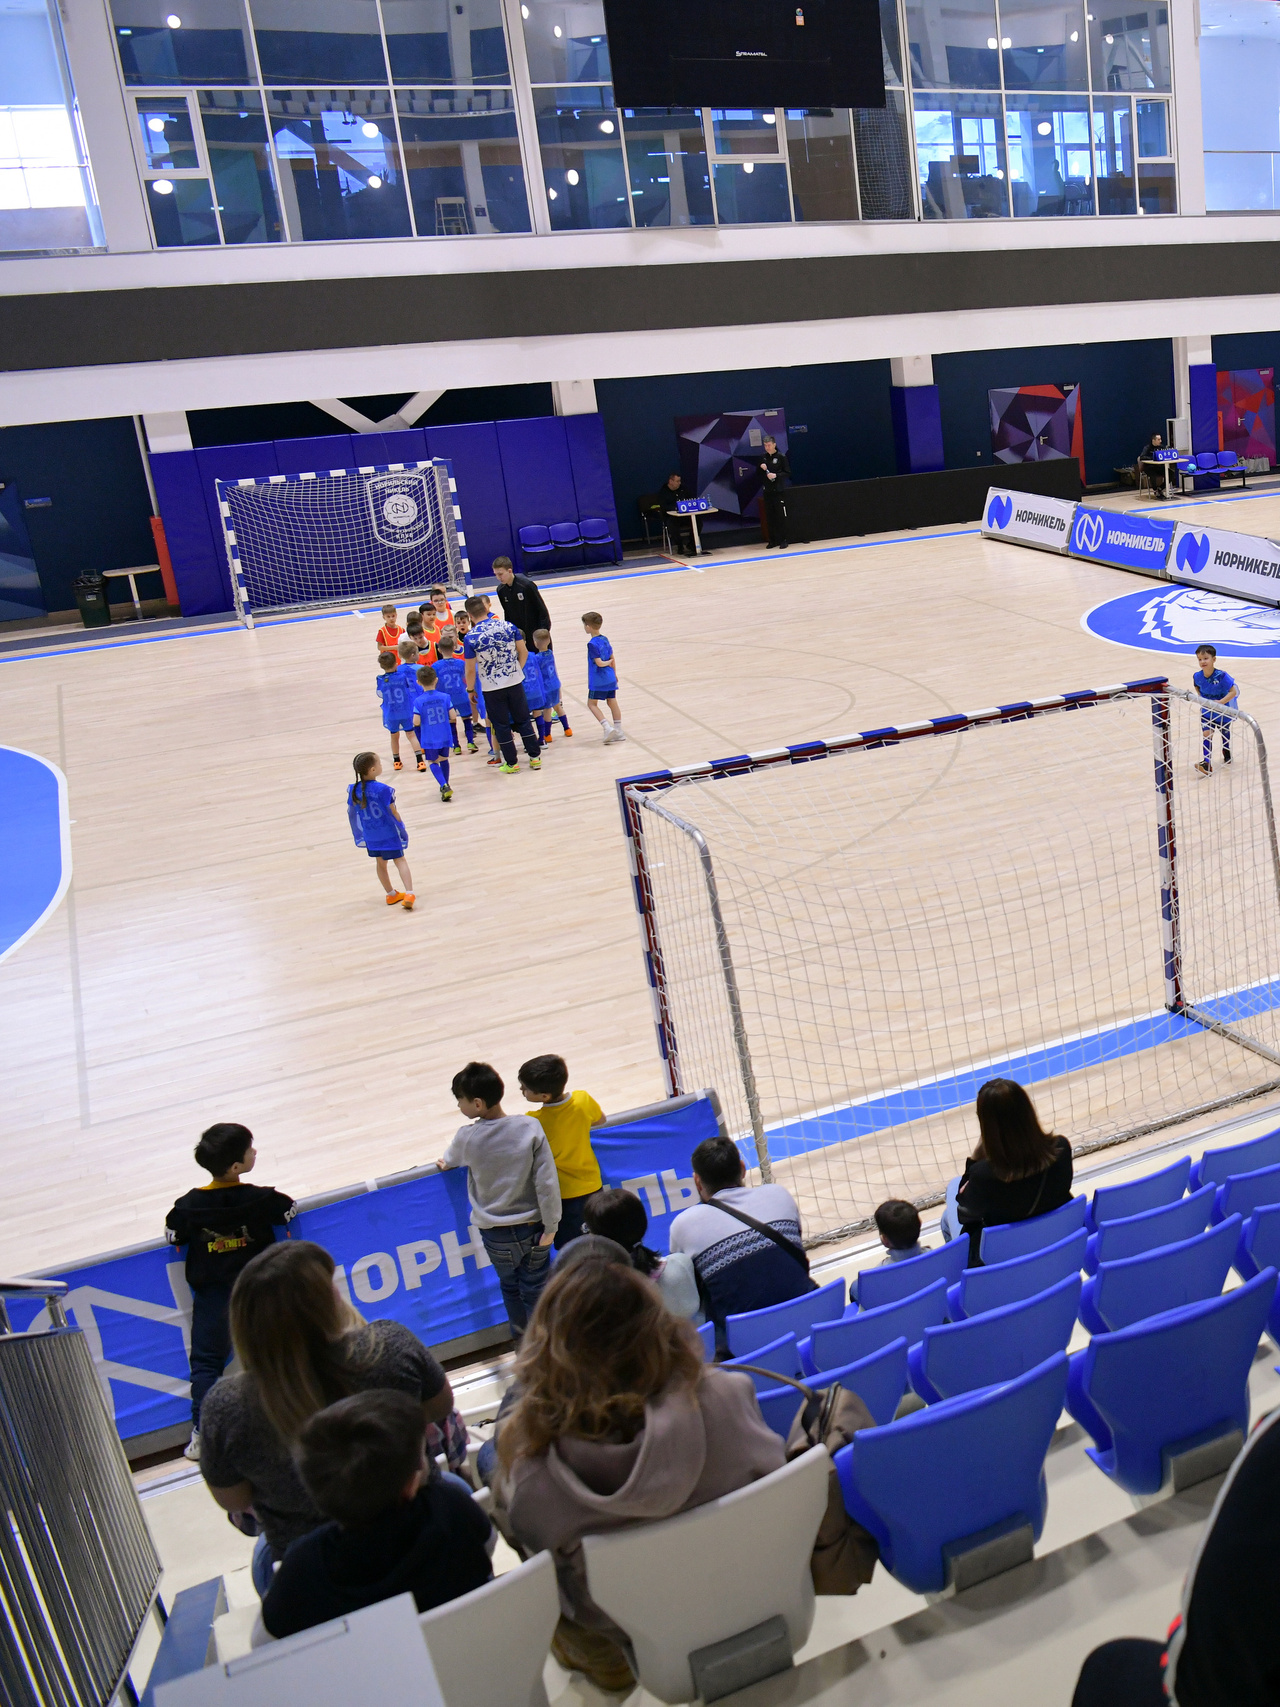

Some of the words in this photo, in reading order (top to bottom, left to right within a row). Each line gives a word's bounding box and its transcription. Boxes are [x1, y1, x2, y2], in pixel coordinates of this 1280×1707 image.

[680, 504, 687, 512] 0
[699, 501, 707, 510] 0
[1015, 509, 1066, 532] НОРНИКЕЛЬ
[1106, 530, 1166, 552] НОРНИКЕЛЬ
[443, 673, 461, 689] 27
[384, 687, 405, 705] 19
[426, 706, 446, 726] 28
[361, 800, 383, 821] 16
[207, 1236, 247, 1253] FORTNITE
